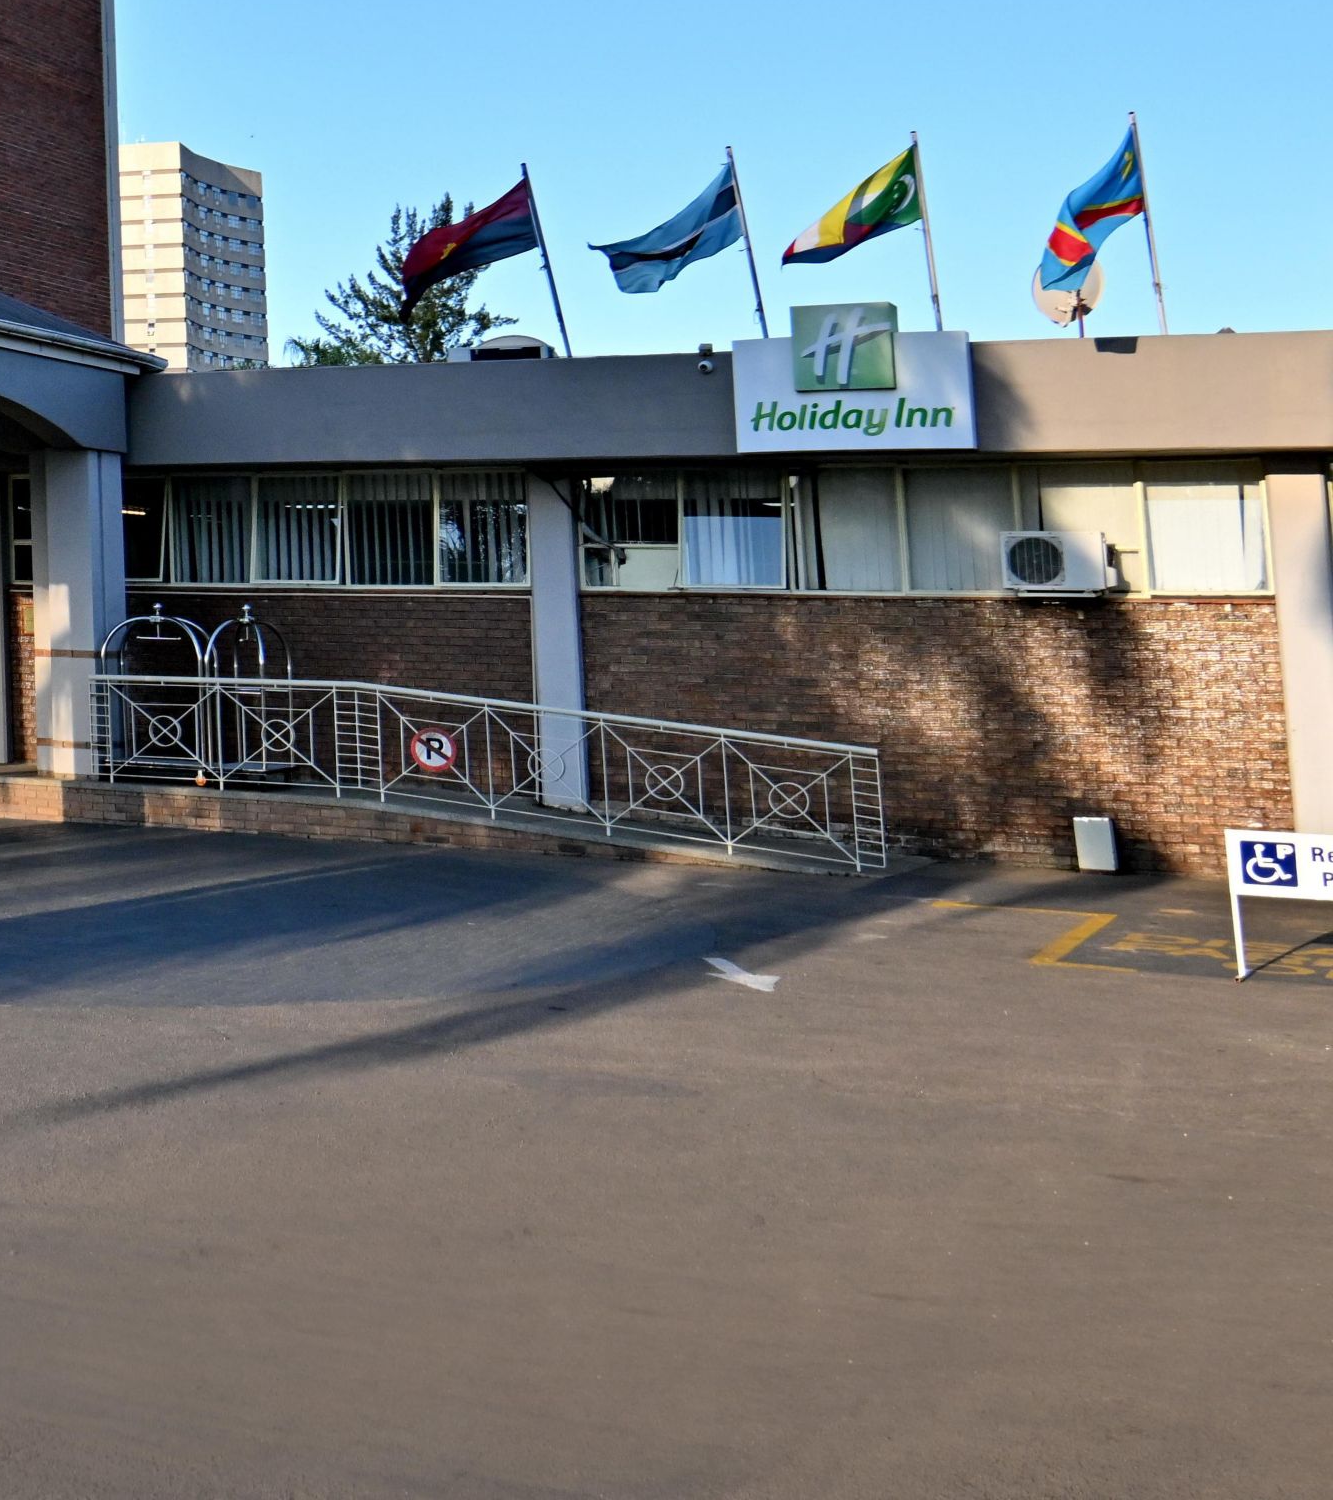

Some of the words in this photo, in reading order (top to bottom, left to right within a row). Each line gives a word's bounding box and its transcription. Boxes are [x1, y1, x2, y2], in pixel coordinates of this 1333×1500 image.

[750, 400, 888, 437] Holiday
[895, 397, 953, 428] Inn
[426, 737, 444, 760] P
